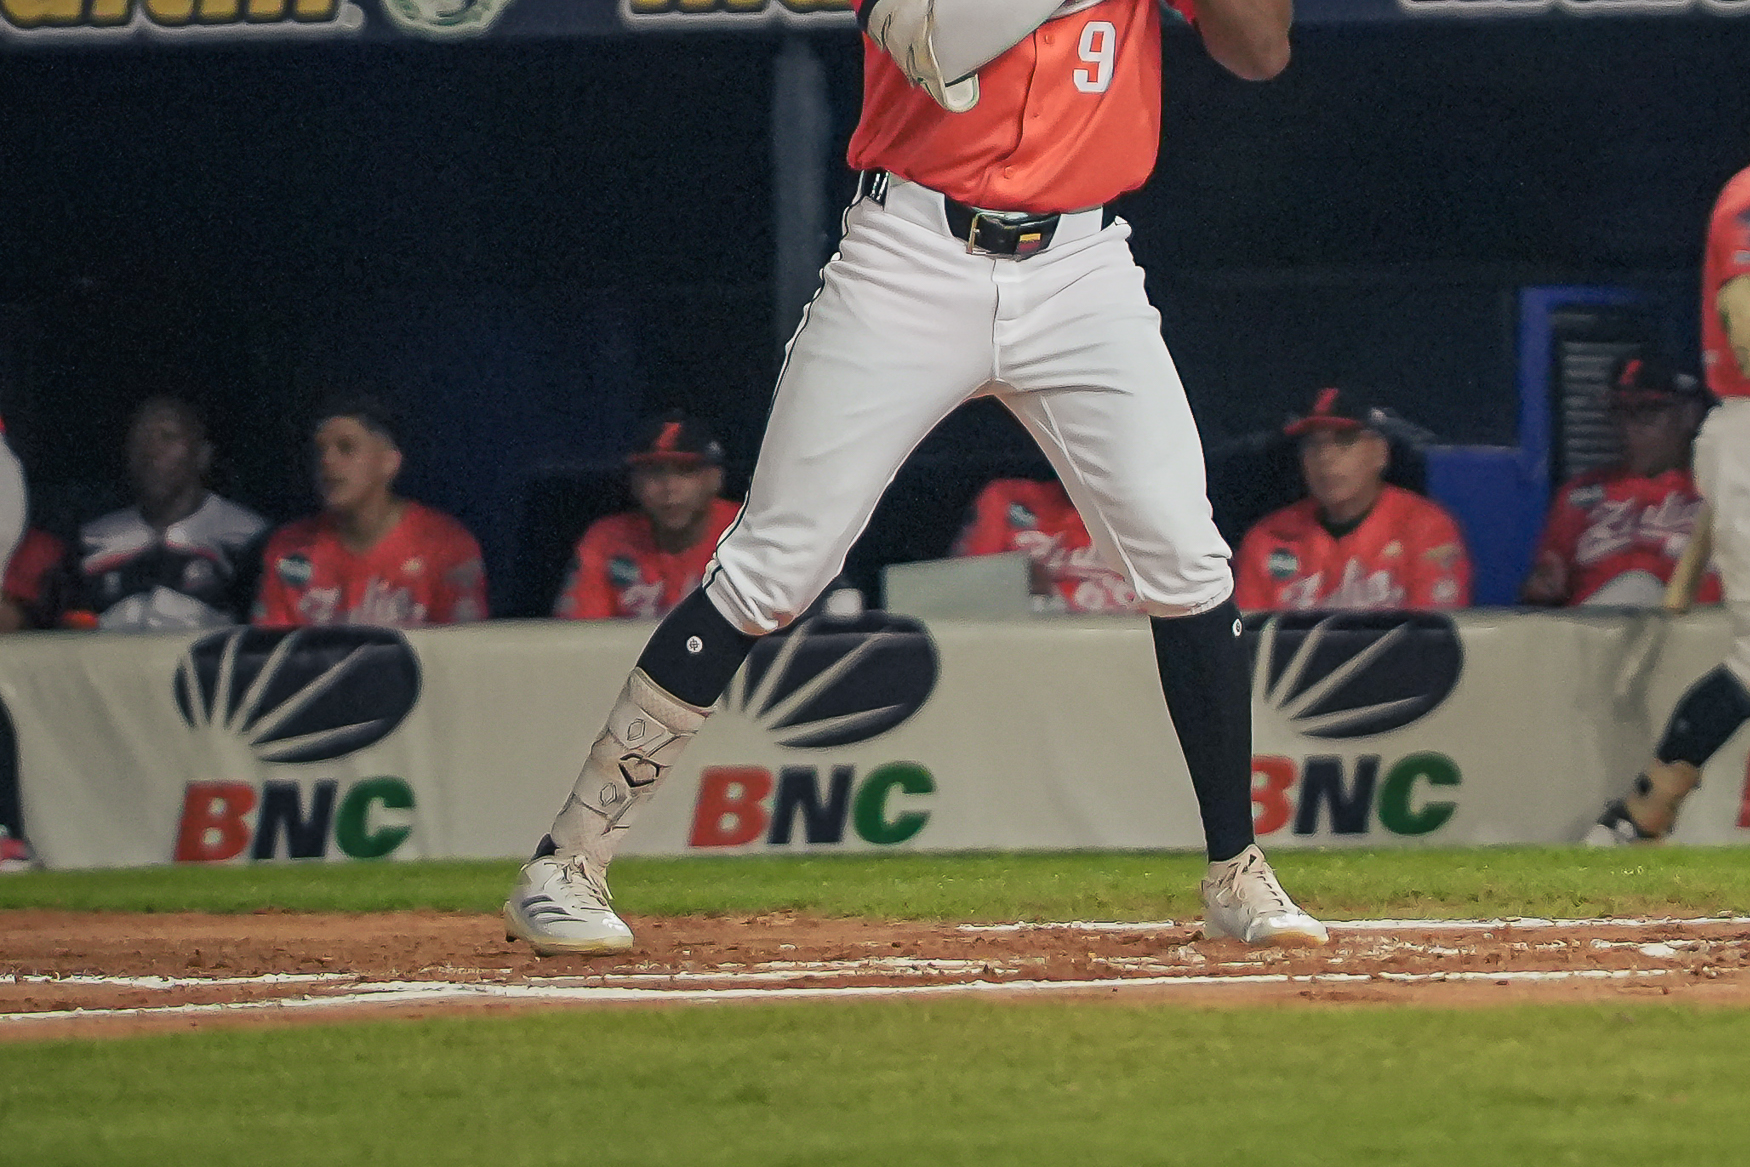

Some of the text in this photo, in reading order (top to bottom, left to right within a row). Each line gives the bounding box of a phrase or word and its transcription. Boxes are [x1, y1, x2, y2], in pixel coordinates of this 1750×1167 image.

[1073, 21, 1117, 93] 9
[173, 775, 416, 863] BNC
[687, 759, 937, 848] BNC
